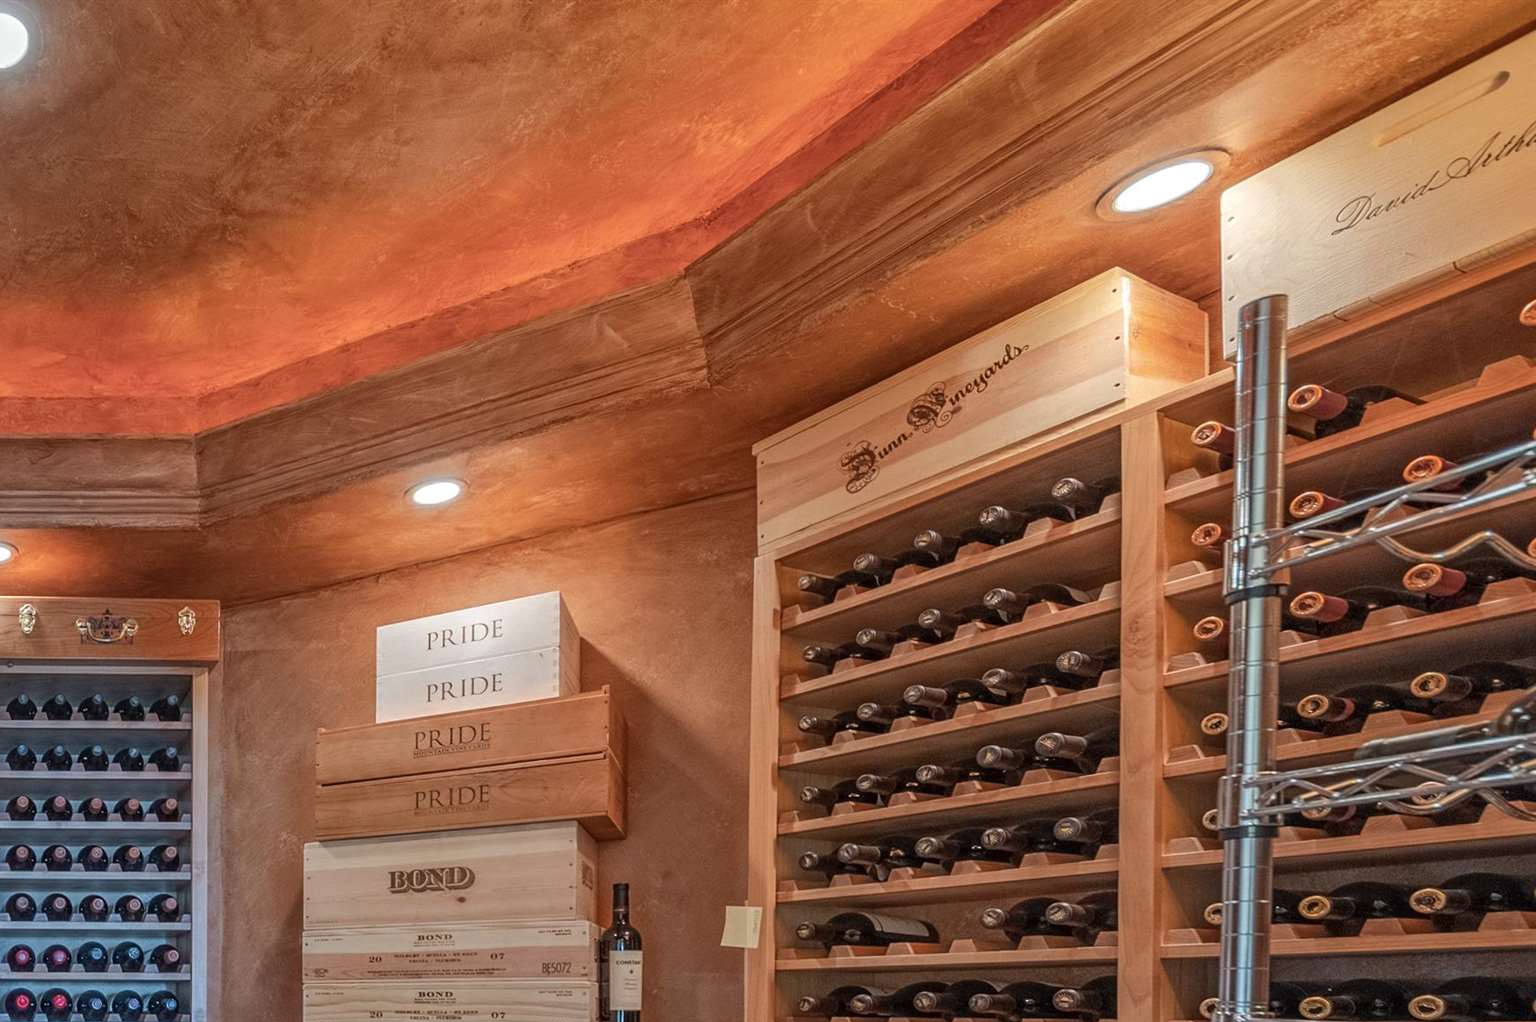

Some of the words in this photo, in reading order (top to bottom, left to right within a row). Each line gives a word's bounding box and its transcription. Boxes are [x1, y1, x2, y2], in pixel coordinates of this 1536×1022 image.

[1331, 170, 1446, 236] David
[906, 344, 1029, 434] Vineyards
[427, 619, 504, 650] PRIDE
[426, 673, 503, 702] PRIDE
[415, 722, 490, 749] PRIDE
[415, 785, 489, 809] PRIDE
[388, 866, 475, 894] BOND
